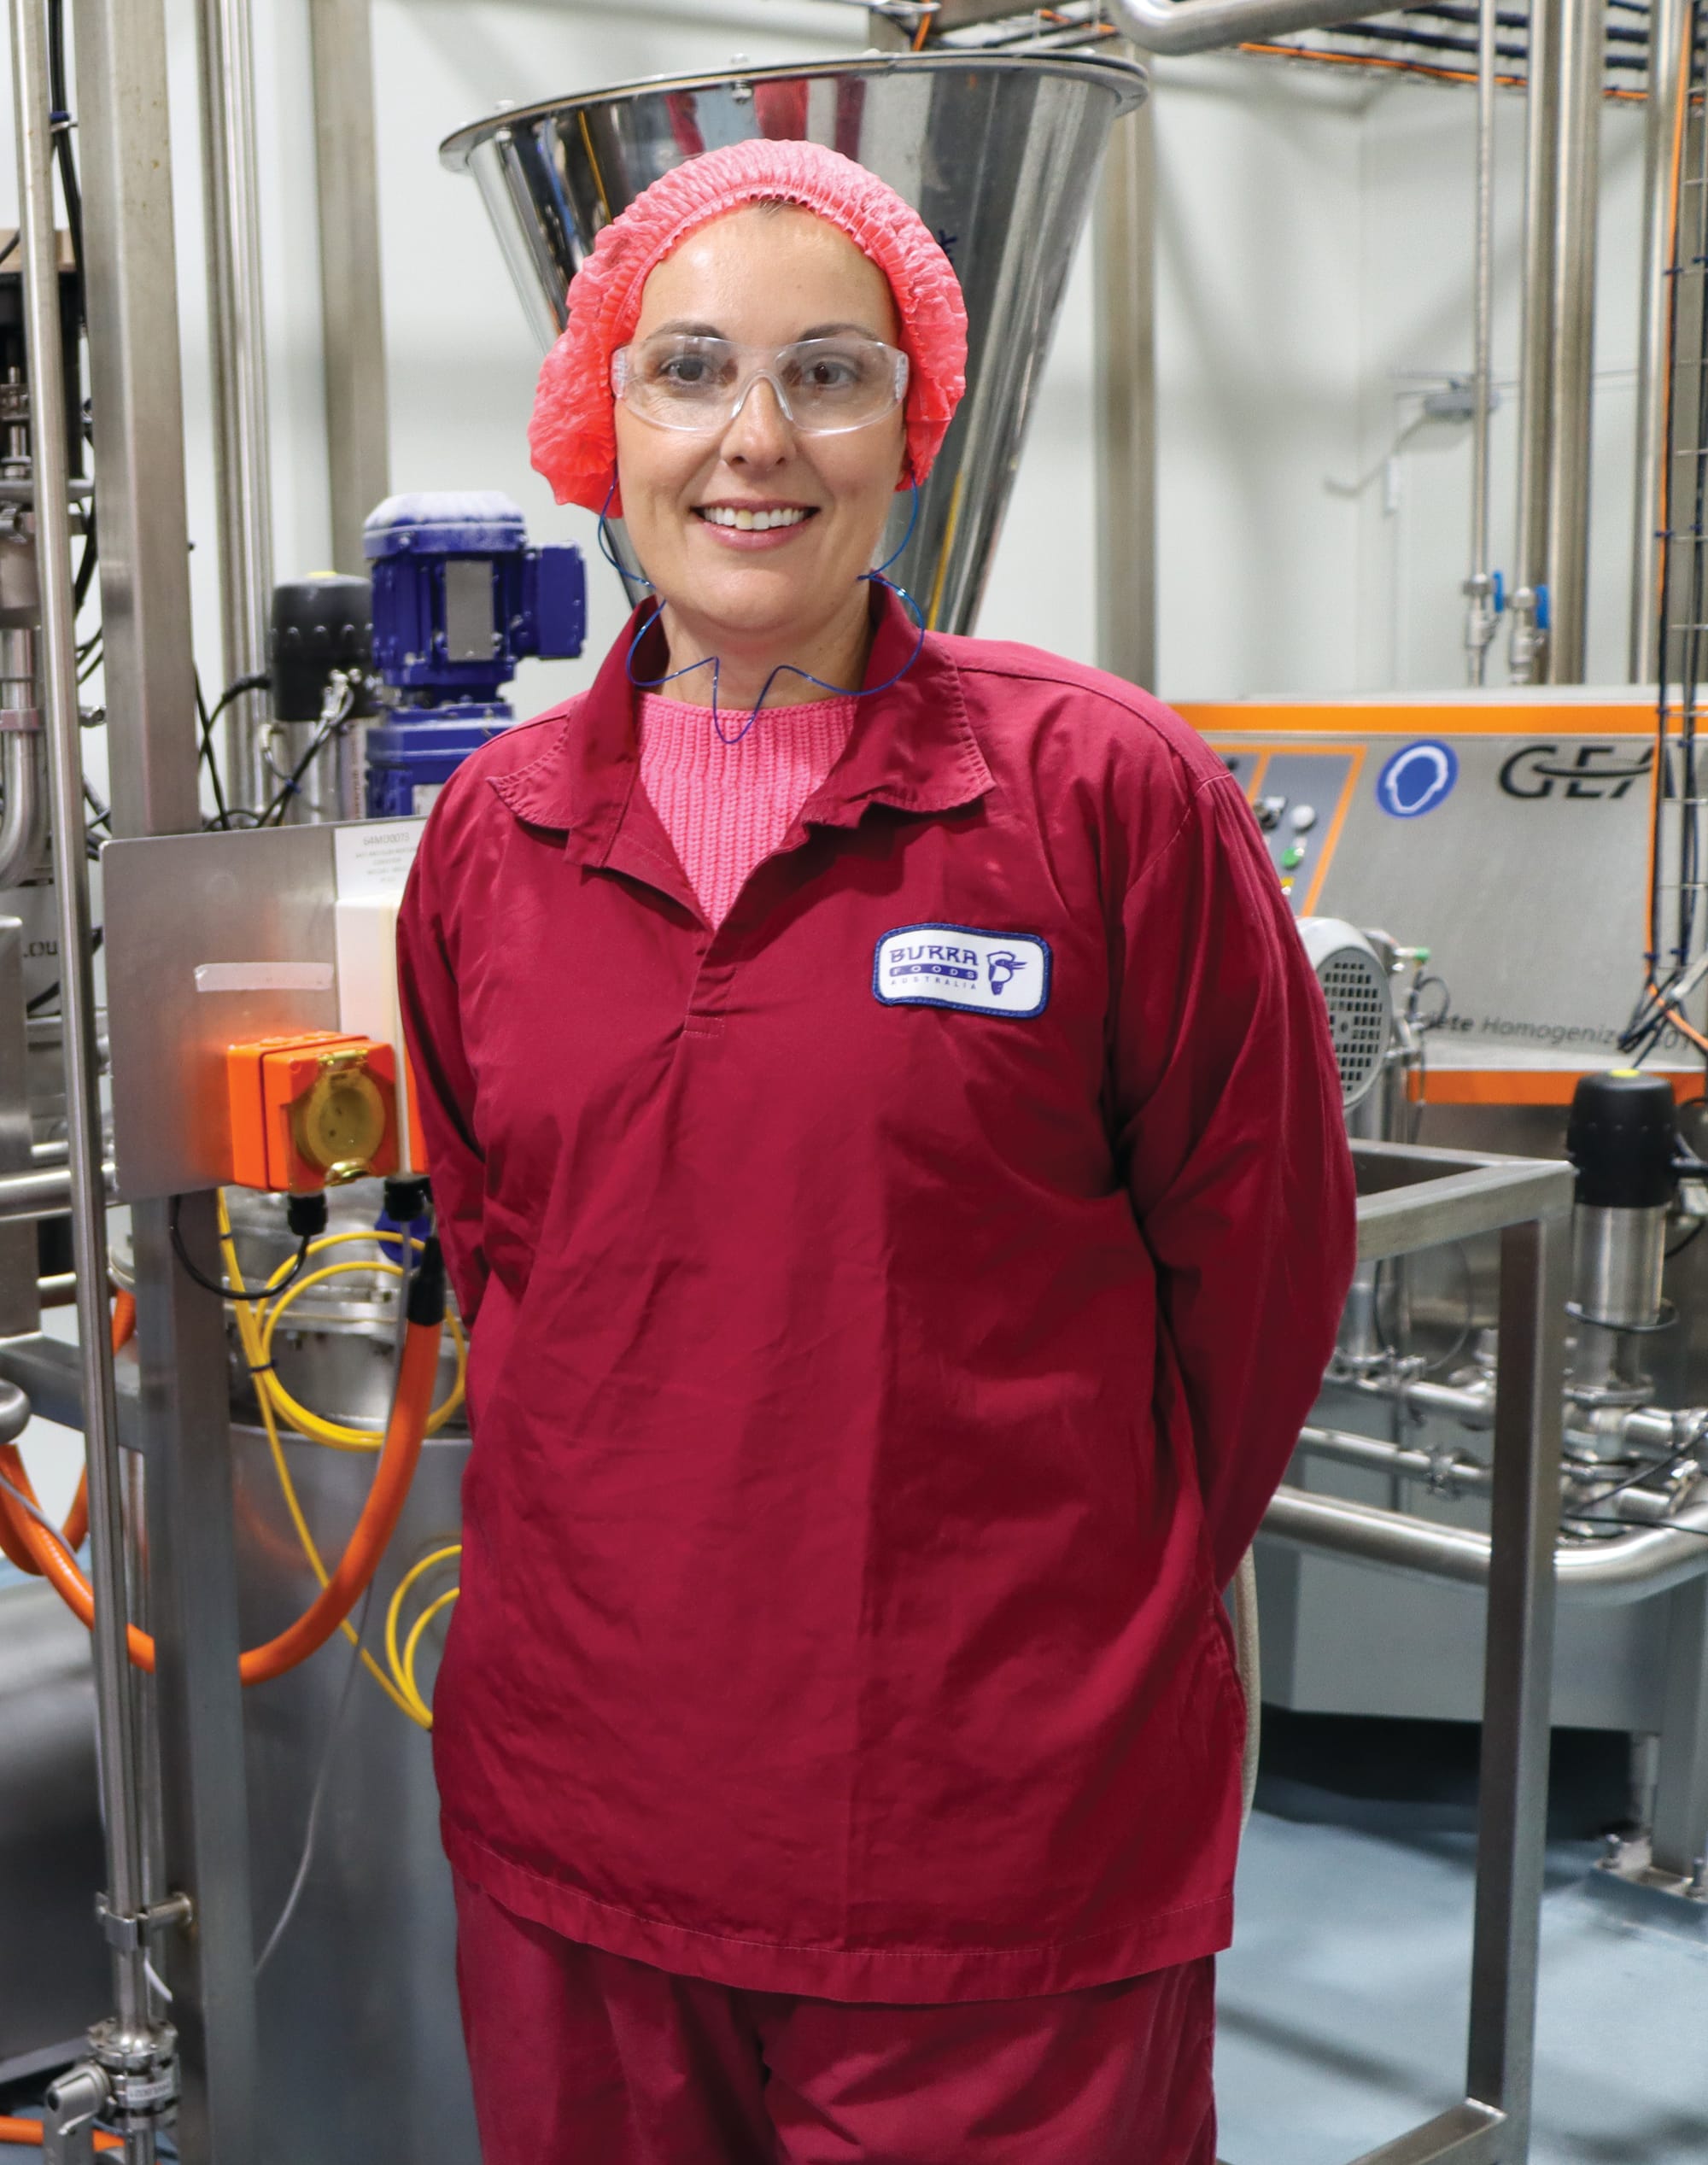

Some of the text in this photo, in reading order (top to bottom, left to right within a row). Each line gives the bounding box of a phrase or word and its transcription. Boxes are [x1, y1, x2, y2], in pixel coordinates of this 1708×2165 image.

[1499, 744, 1676, 799] GEA
[889, 945, 980, 966] BURRA
[890, 975, 977, 990] AUSTRALIA
[891, 964, 976, 980] FOODS
[1482, 1015, 1617, 1046] Homogeniz
